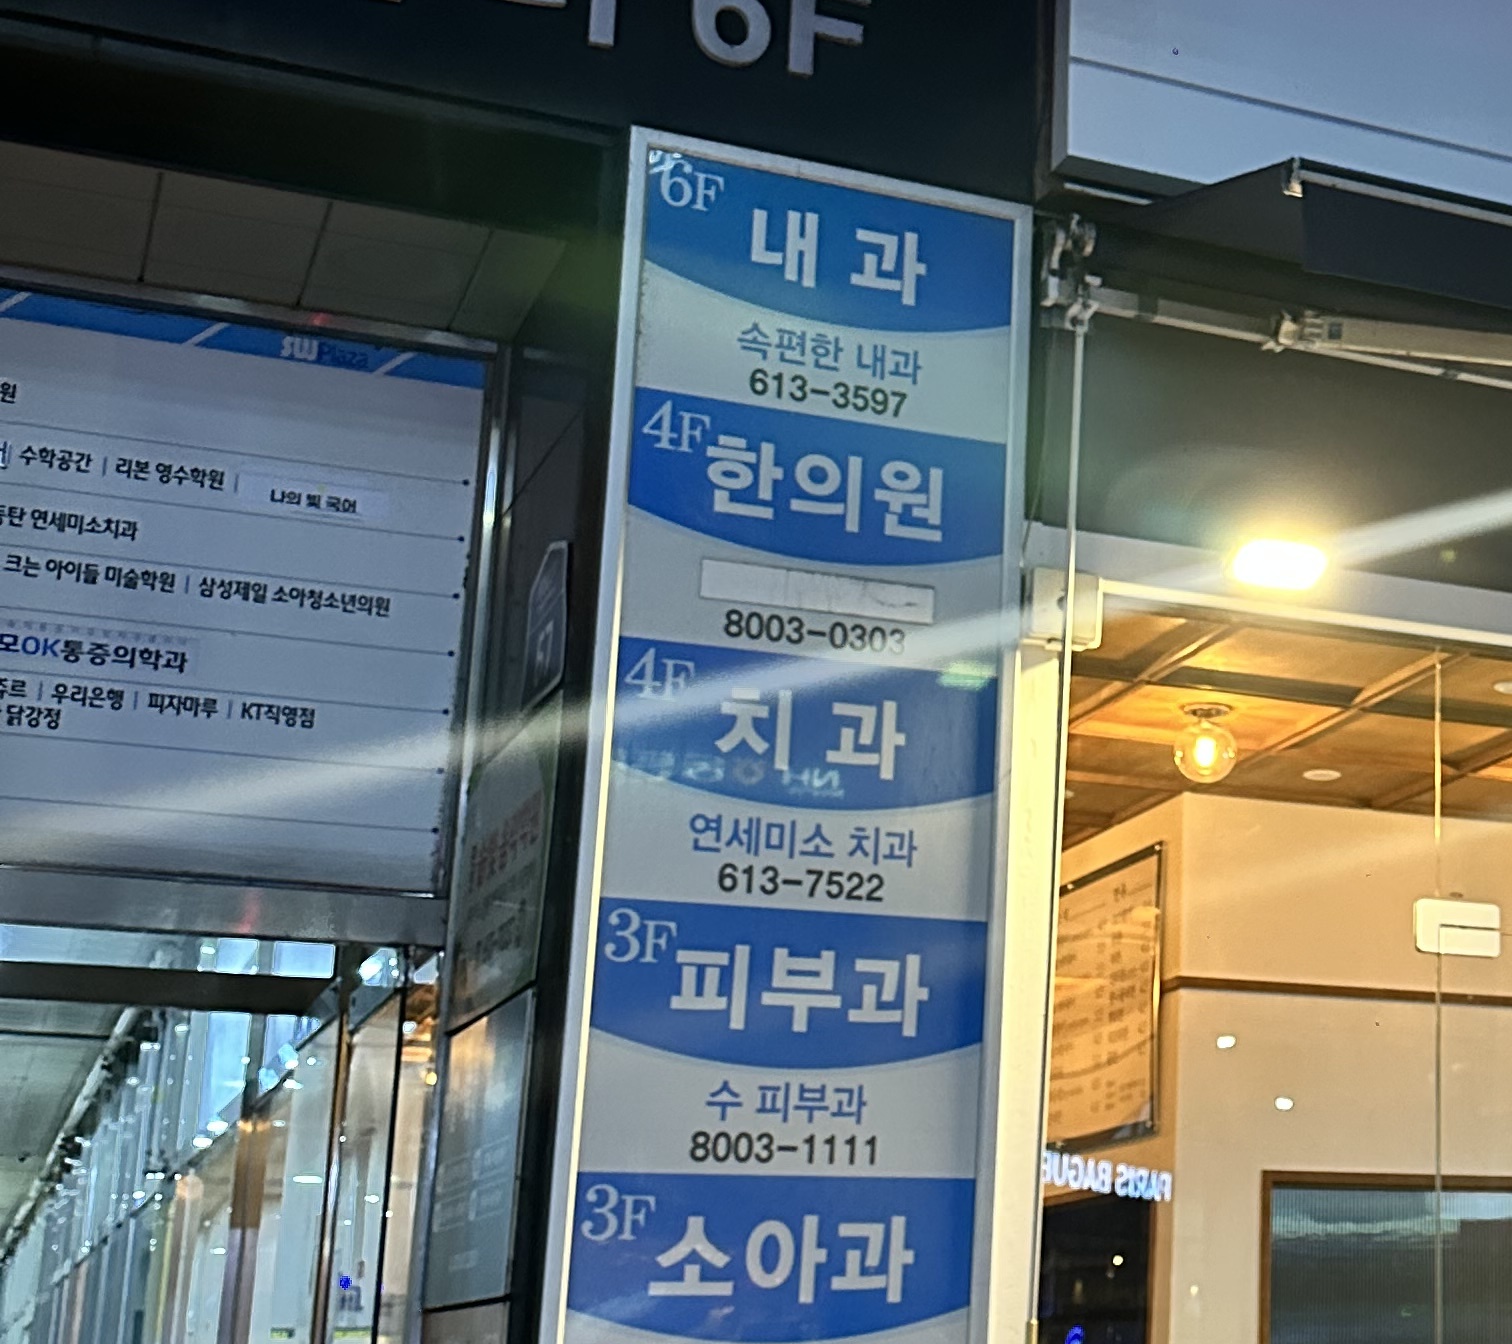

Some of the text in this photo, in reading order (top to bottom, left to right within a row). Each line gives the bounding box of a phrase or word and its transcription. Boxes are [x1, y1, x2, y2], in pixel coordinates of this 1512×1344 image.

[660, 158, 725, 212] 6F
[736, 321, 923, 385] 속편한 내과
[748, 368, 908, 420] 613-3597
[642, 400, 710, 453] 4F
[18, 445, 93, 473] 수학공간
[155, 462, 226, 492] 영수학원
[705, 433, 944, 543] 한의원
[30, 508, 139, 541] 연세미소치과
[3, 554, 391, 617] 크는 아이들 미술학원 삼성제일 소아청소년의원
[723, 609, 907, 656] 8003-0303
[624, 646, 696, 703] 4F
[6, 704, 61, 730] 닭강정
[51, 683, 125, 711] 우리은행
[148, 692, 219, 719] 피자마루
[241, 702, 316, 729] KT직영점
[688, 812, 918, 868] 연세미소 치과
[716, 862, 885, 903] 613-7522
[603, 907, 677, 964] 3F
[669, 943, 930, 1038] 피부과
[706, 1079, 868, 1126] 수 피부과
[689, 1130, 879, 1167] 8003-1111
[580, 1183, 656, 1241] 3F
[647, 1215, 915, 1304] 소아과
